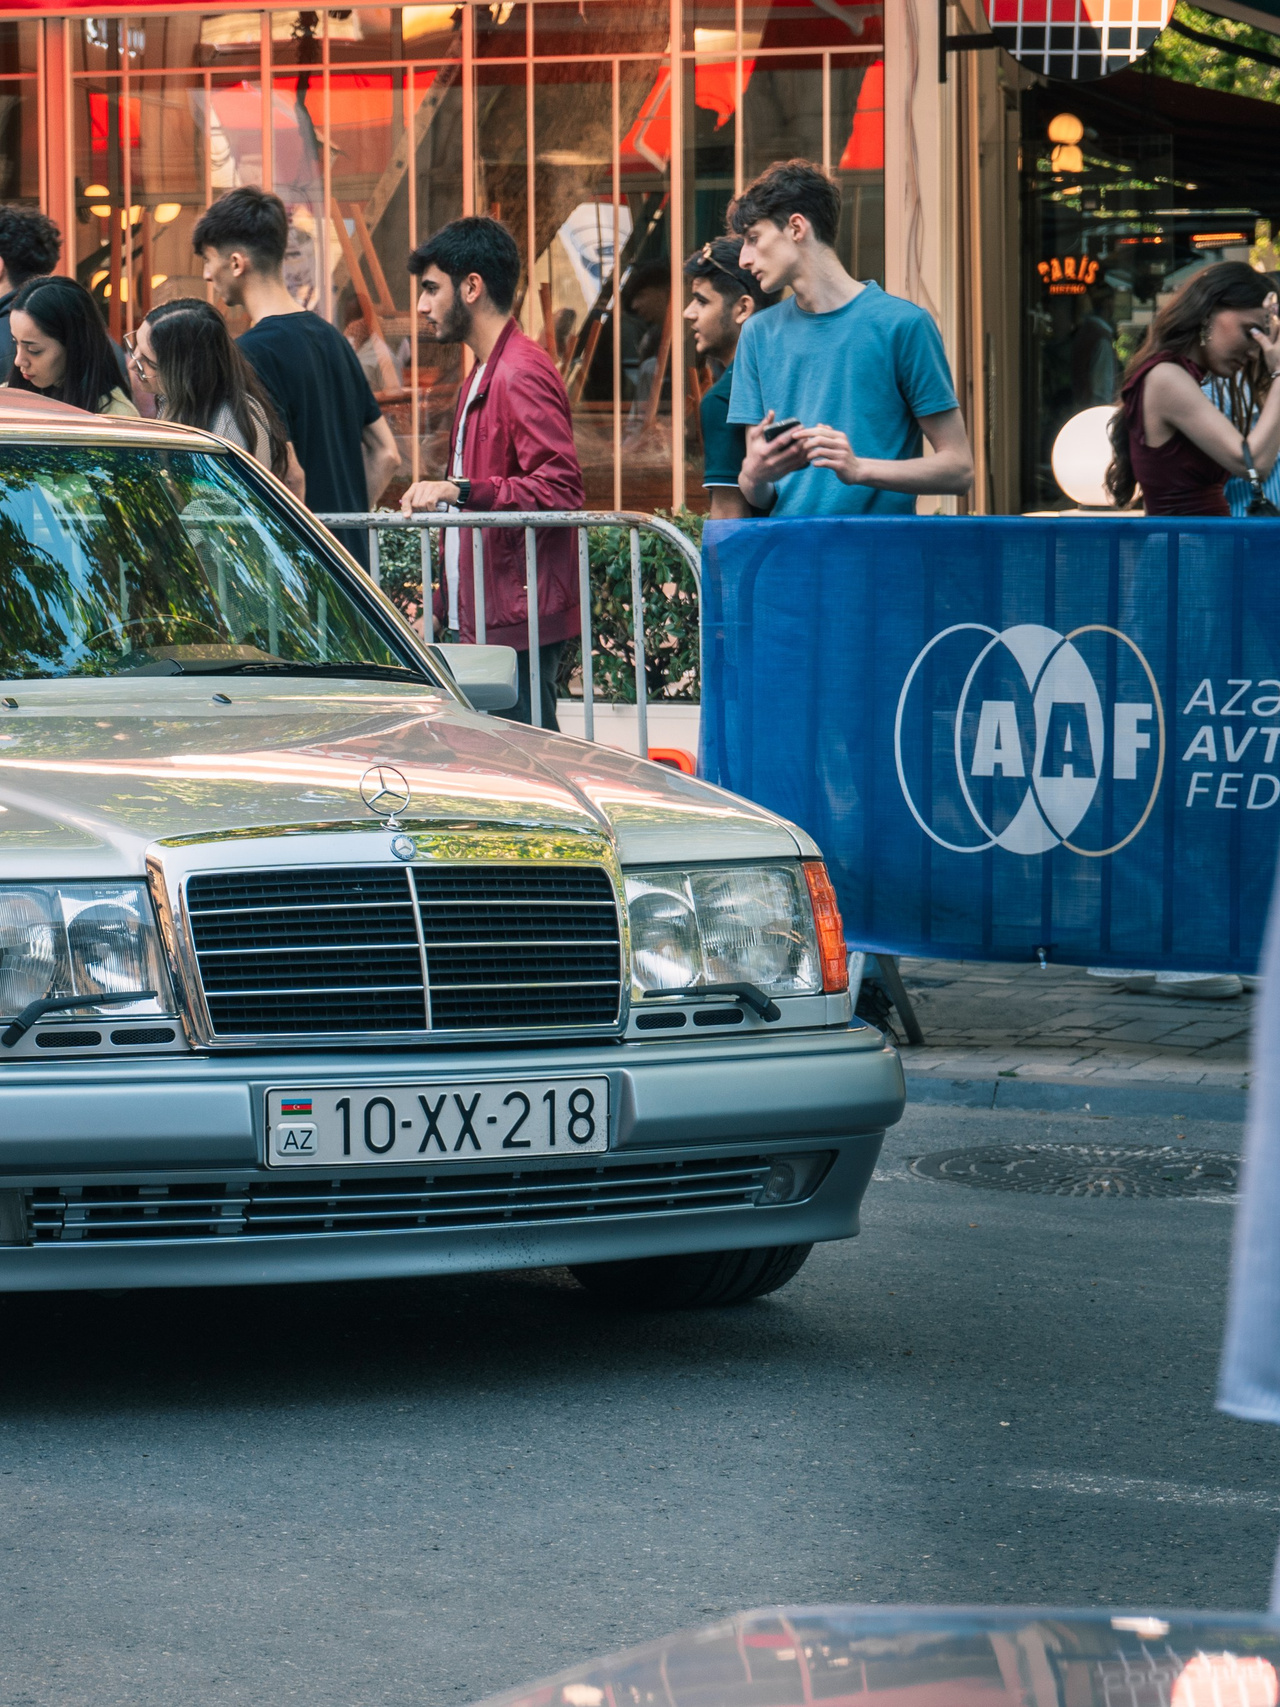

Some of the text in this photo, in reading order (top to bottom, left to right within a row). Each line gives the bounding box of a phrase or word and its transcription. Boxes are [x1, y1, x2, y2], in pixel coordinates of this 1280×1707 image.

[971, 700, 1152, 780] AAF
[1182, 725, 1280, 764] AVT
[1186, 771, 1280, 810] FED
[283, 1130, 313, 1150] AZ
[335, 1088, 595, 1155] 10-XX-218
